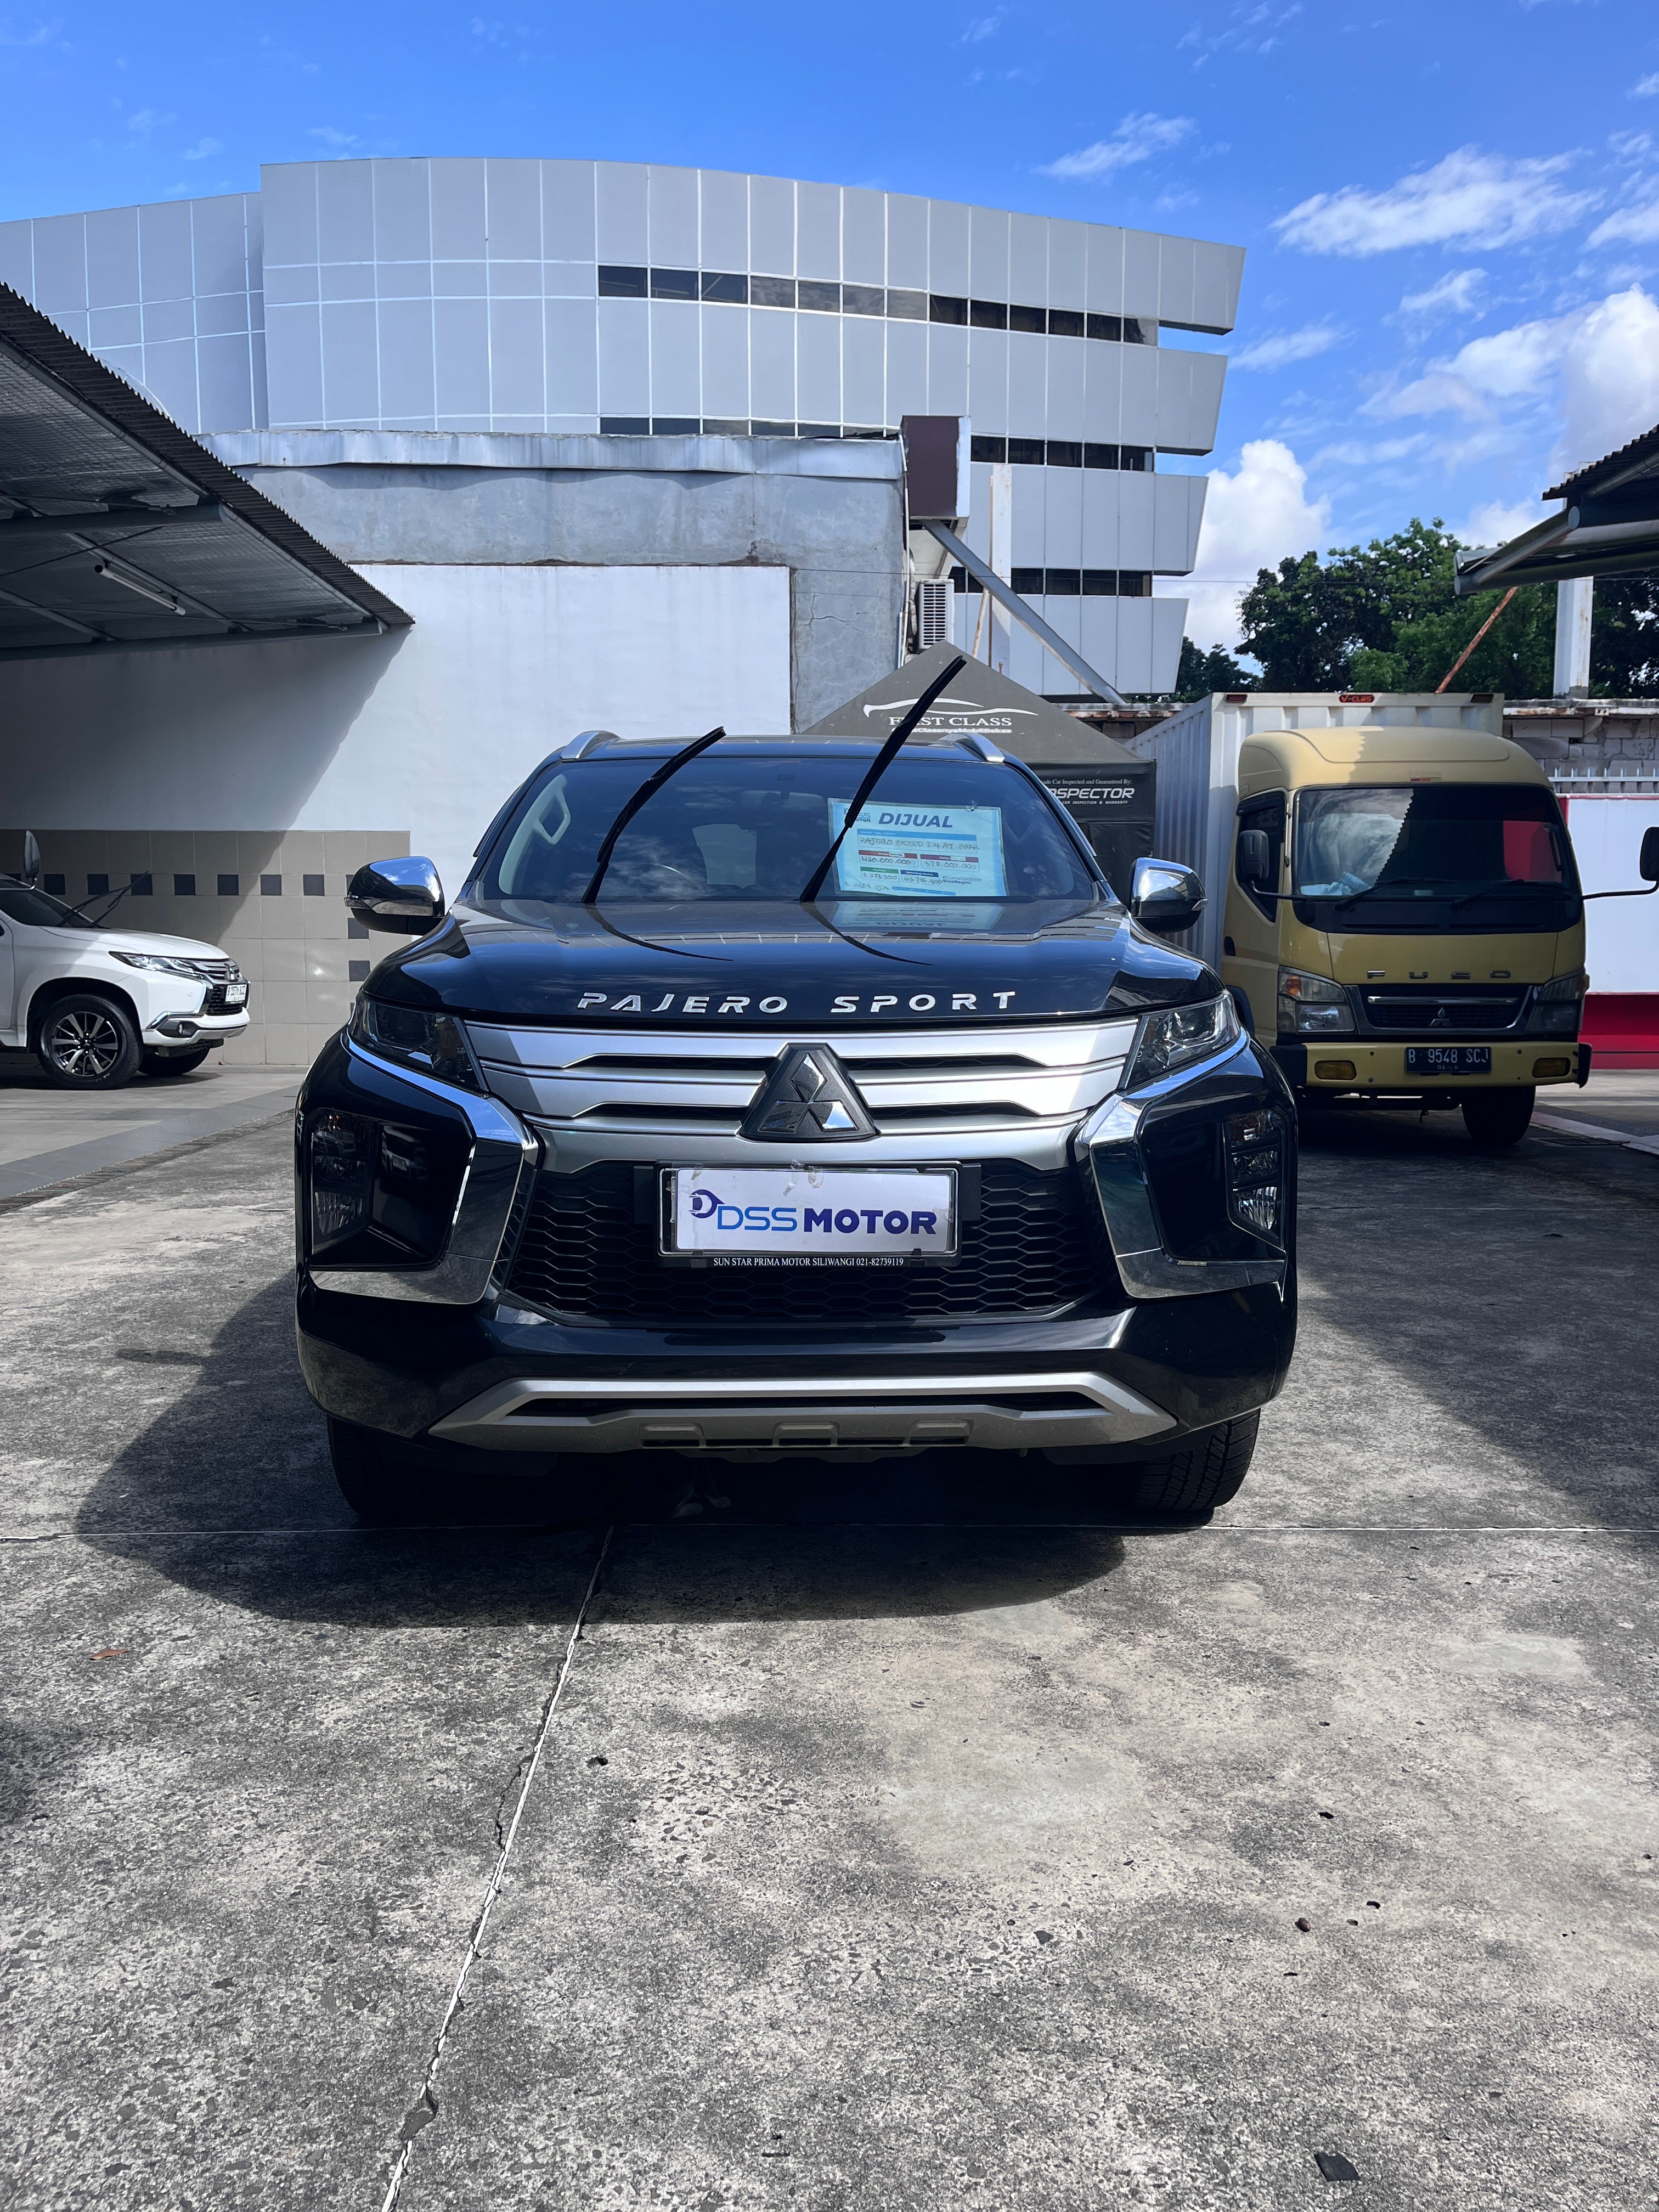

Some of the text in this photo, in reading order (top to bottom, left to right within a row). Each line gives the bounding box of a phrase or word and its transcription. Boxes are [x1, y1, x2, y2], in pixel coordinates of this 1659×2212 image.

[888, 717, 1012, 726] FST CLASS
[878, 812, 953, 828] DIJUAL
[860, 837, 893, 845] PAJERO
[1367, 970, 1511, 979] FUSO
[578, 991, 1016, 1014] PAJERO SPORT
[1408, 1048, 1415, 1063] B
[1428, 1048, 1458, 1063] 9548
[803, 1207, 937, 1235] MOTOR
[713, 1257, 904, 1266] SUN STAR PRIMA MOTOR SILIWANGI 021-82739119
